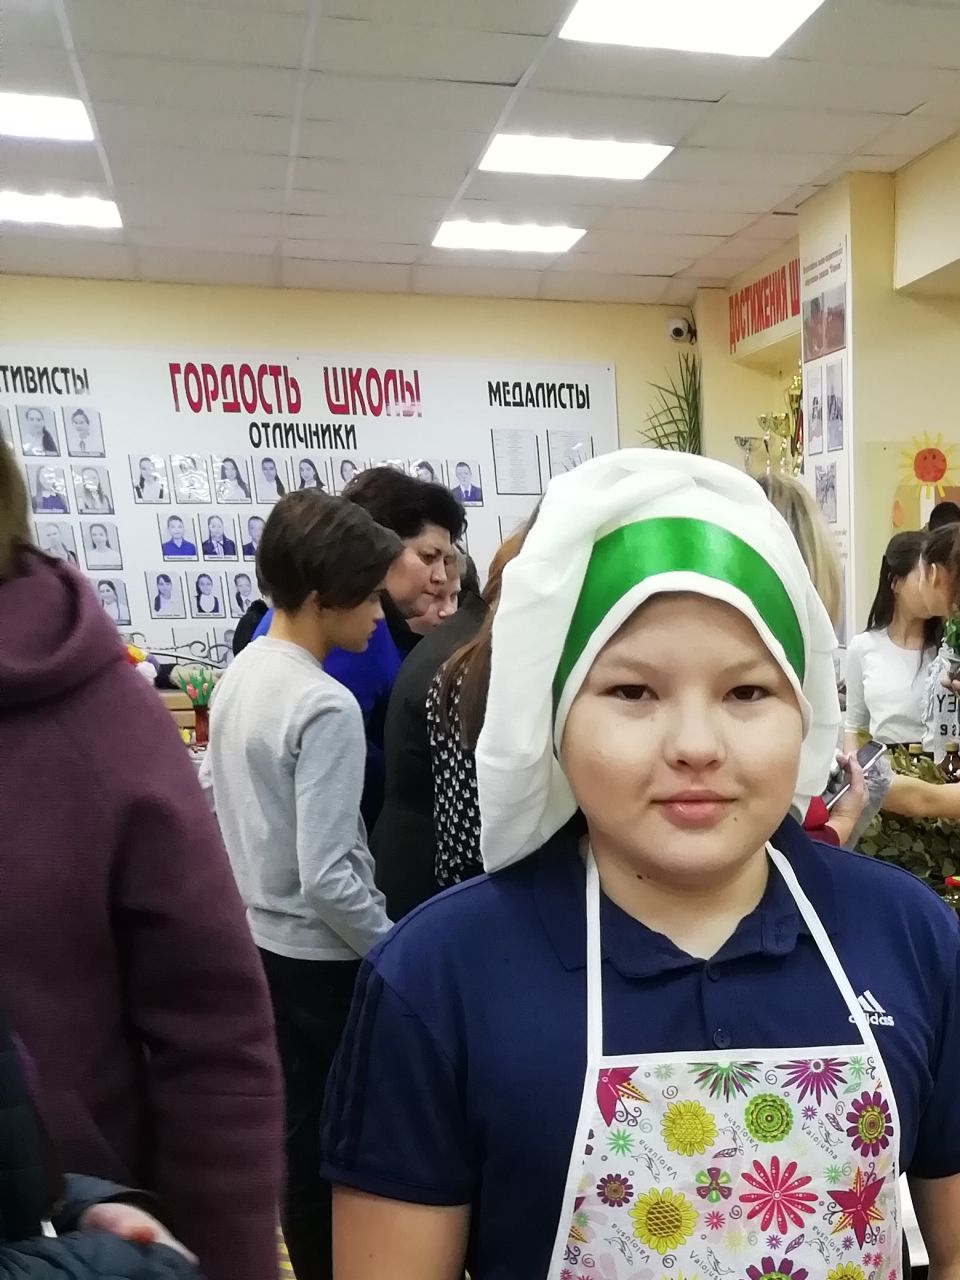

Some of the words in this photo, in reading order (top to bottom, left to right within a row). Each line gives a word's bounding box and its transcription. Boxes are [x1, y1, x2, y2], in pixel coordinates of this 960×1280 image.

[728, 265, 788, 355] ДОСТИЖЕНИЯ
[0, 365, 90, 395] ТИВИСТЫ
[169, 362, 301, 414] ГОРДОСТЬ
[323, 366, 422, 417] ШКОЛЫ
[487, 381, 590, 409] МЕДАЛИСТЫ
[249, 422, 358, 450] ОТЛИЧНИКИ
